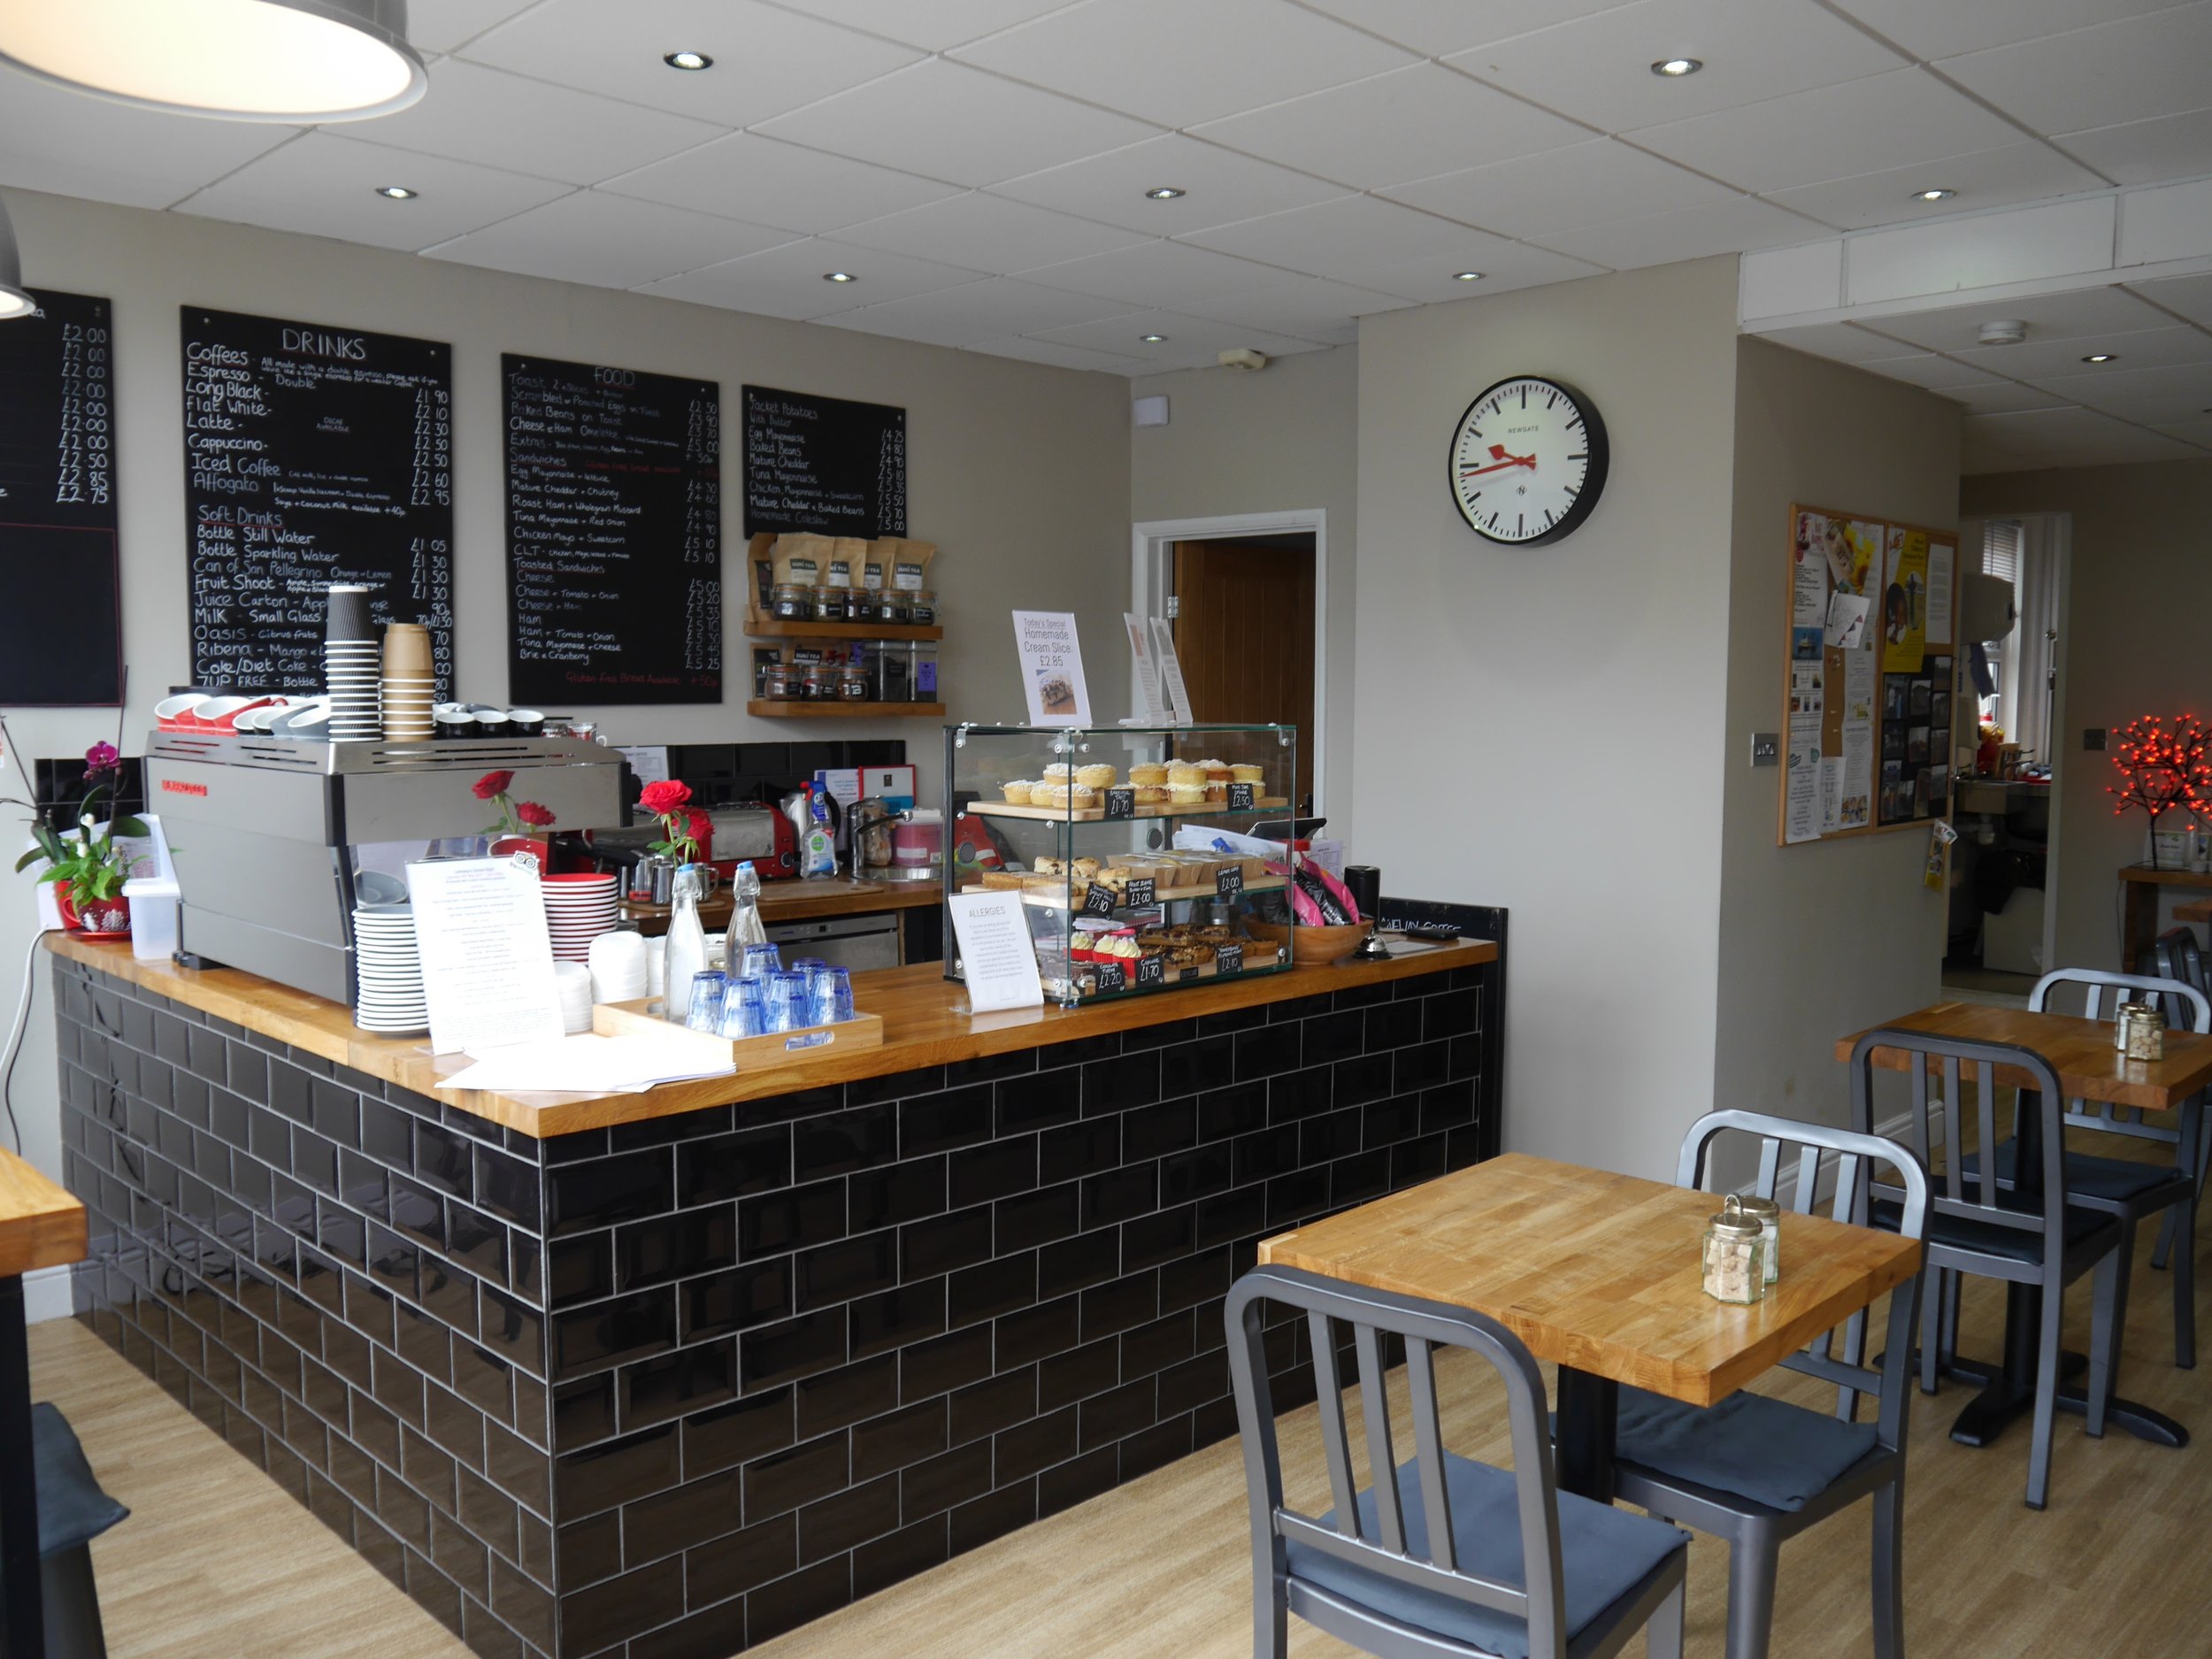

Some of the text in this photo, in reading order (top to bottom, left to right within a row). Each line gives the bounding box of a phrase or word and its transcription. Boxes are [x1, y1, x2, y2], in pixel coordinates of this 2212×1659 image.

[283, 328, 366, 360] DRINKS
[187, 342, 248, 365] Coffees
[188, 361, 250, 383] Espresso
[509, 373, 545, 388] Toast
[594, 367, 635, 387] FOOD
[275, 373, 317, 389] Double
[186, 378, 261, 403] Long Black
[186, 396, 220, 412] Flat
[511, 387, 563, 404] Scrambled
[608, 401, 626, 414] Eggs
[750, 399, 818, 419] Jacket Potatoes
[511, 402, 542, 416] Baked
[545, 406, 575, 420] Beans
[187, 411, 234, 430] Latte
[510, 417, 545, 431] Cheese
[554, 422, 572, 434] Ham
[511, 433, 545, 449] Extras
[749, 426, 805, 443] Egg Mayonnaise
[749, 438, 802, 457] Baked Beans
[191, 452, 232, 474] Iced
[237, 457, 281, 477] Coffee
[510, 447, 566, 466] Sandwiches
[749, 452, 810, 468] Mature Cheddar
[511, 464, 575, 481] Egg Mayonnaise
[749, 466, 818, 484] Tuna Mayonnaise
[194, 472, 259, 494] Affogato
[511, 480, 619, 500] Mature Cheddar Chutney
[785, 485, 822, 497] Mayonnaise
[512, 494, 641, 514] Roast Ham Mustard
[750, 495, 864, 516] Mature Cheddar Baked Beans
[197, 504, 283, 527] Soft Drinks
[512, 510, 534, 522] Tuna
[588, 516, 603, 526] Red
[750, 509, 791, 522] Homemade
[197, 524, 235, 539] Bottle
[243, 526, 267, 541] Still
[272, 528, 316, 544] Water
[513, 526, 626, 546] Chicken Mayo Sweetcorn
[197, 541, 237, 557] Bottle
[243, 545, 296, 562] Sparkling
[301, 549, 340, 562] Water
[513, 543, 541, 556] CLT
[193, 557, 221, 573] Can
[227, 557, 239, 574] of
[242, 561, 264, 575] San
[270, 561, 323, 579] Pellegrino
[513, 557, 605, 573] Toasted Sandwiches
[195, 574, 230, 589] Fruit
[233, 574, 276, 590] Shoot
[517, 570, 555, 583] Cheese
[195, 590, 234, 607] Juice
[238, 592, 288, 608] Carton
[515, 584, 550, 597] Cheese
[561, 588, 589, 598] Tomato
[518, 599, 553, 610] Cheese
[249, 609, 321, 623] Small Glass
[518, 613, 541, 625] Ham
[1024, 618, 1066, 628] Today's Special
[258, 629, 291, 639] Citrus
[518, 626, 615, 641] Ham Tomato Onion
[1024, 628, 1069, 640] Homemade
[197, 641, 307, 658] Ribena Mango
[517, 637, 542, 649] Tuna
[1024, 641, 1071, 653] Cream Slice
[196, 657, 307, 675] Coke/Diet Coke
[519, 649, 589, 666] Brie Cranberry
[1040, 656, 1064, 666] £2.85
[238, 675, 267, 687] FREE
[283, 677, 319, 687] Bottle
[1110, 799, 1130, 815] £1.70
[1233, 794, 1250, 807] £2.50
[1221, 876, 1240, 892] £2.00
[1088, 892, 1109, 912] £2.10
[1131, 893, 1150, 906] £2.00
[969, 906, 1005, 918] ALLERGIES
[1099, 972, 1122, 988] £2.20
[1141, 964, 1159, 981] £1.70
